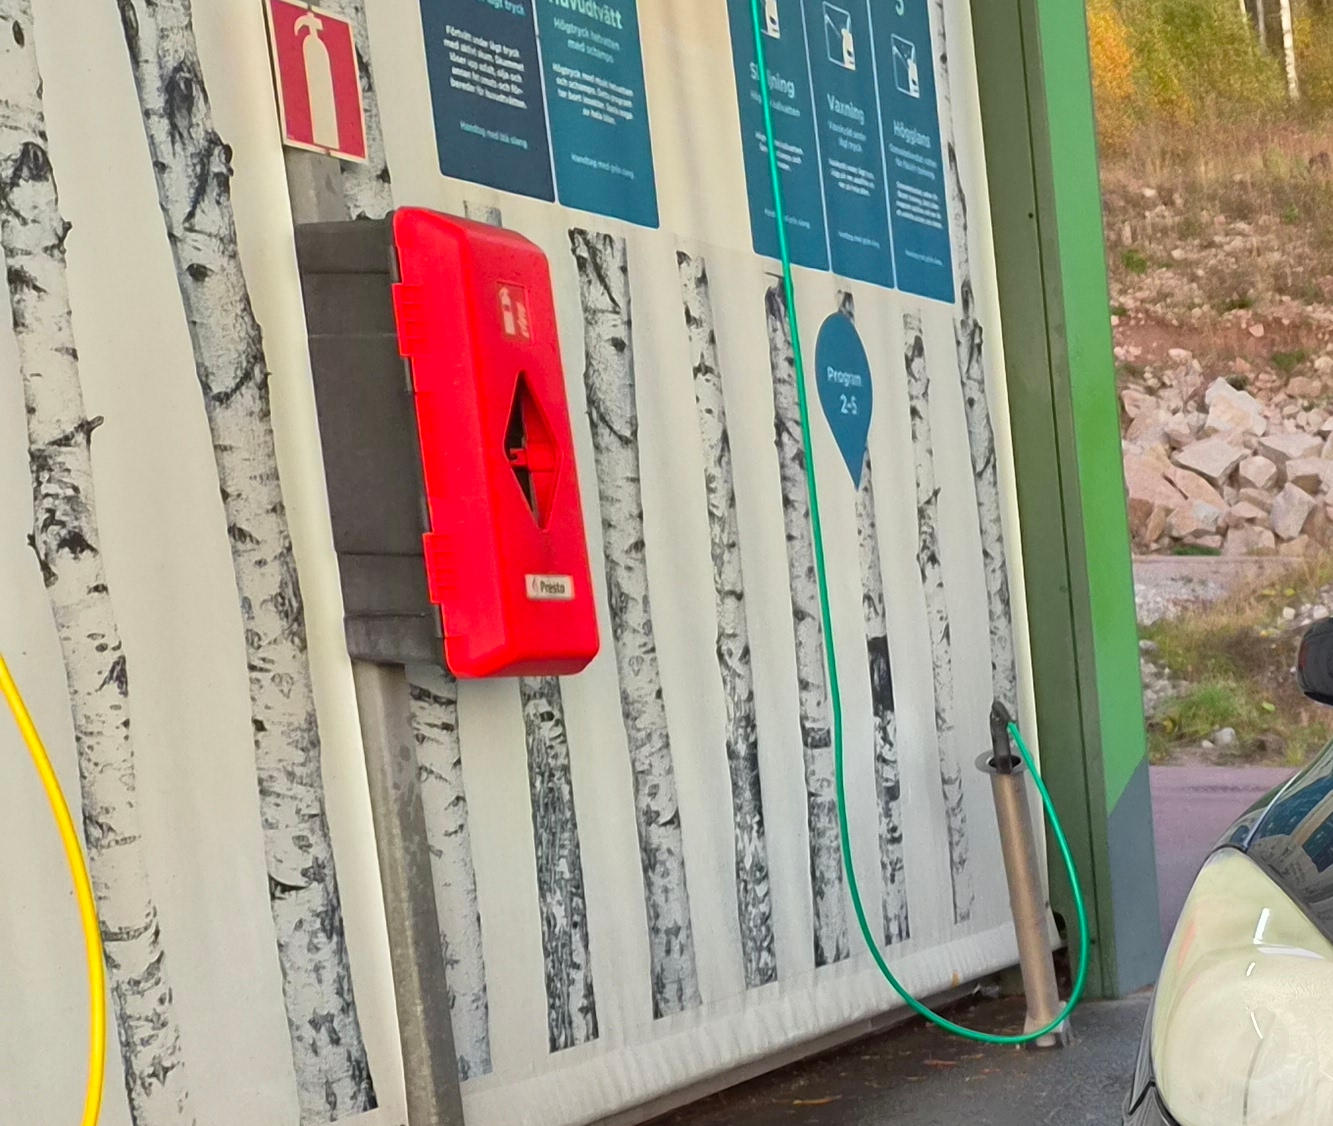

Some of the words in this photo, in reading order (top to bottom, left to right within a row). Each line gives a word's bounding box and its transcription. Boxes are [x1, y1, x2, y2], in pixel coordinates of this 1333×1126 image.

[548, 0, 623, 29] uvudtvätt
[827, 366, 862, 387] Program
[840, 394, 858, 415] 2-5
[540, 580, 565, 594] Presto
